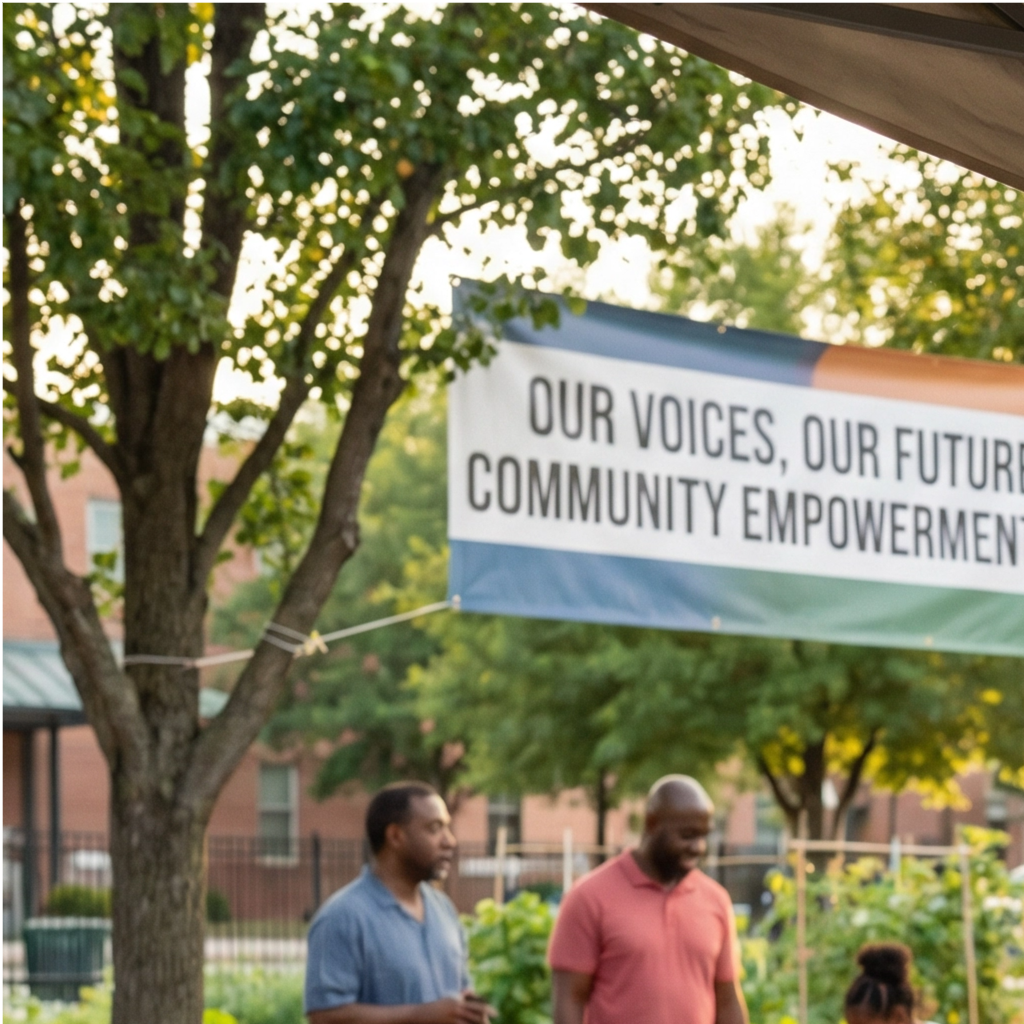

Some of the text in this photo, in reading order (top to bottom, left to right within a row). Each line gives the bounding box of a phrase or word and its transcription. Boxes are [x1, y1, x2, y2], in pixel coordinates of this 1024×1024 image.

[528, 376, 615, 444] OUR
[630, 389, 788, 475] VOICES,
[802, 413, 881, 479] OUR
[466, 451, 727, 538] COMMUNITY
